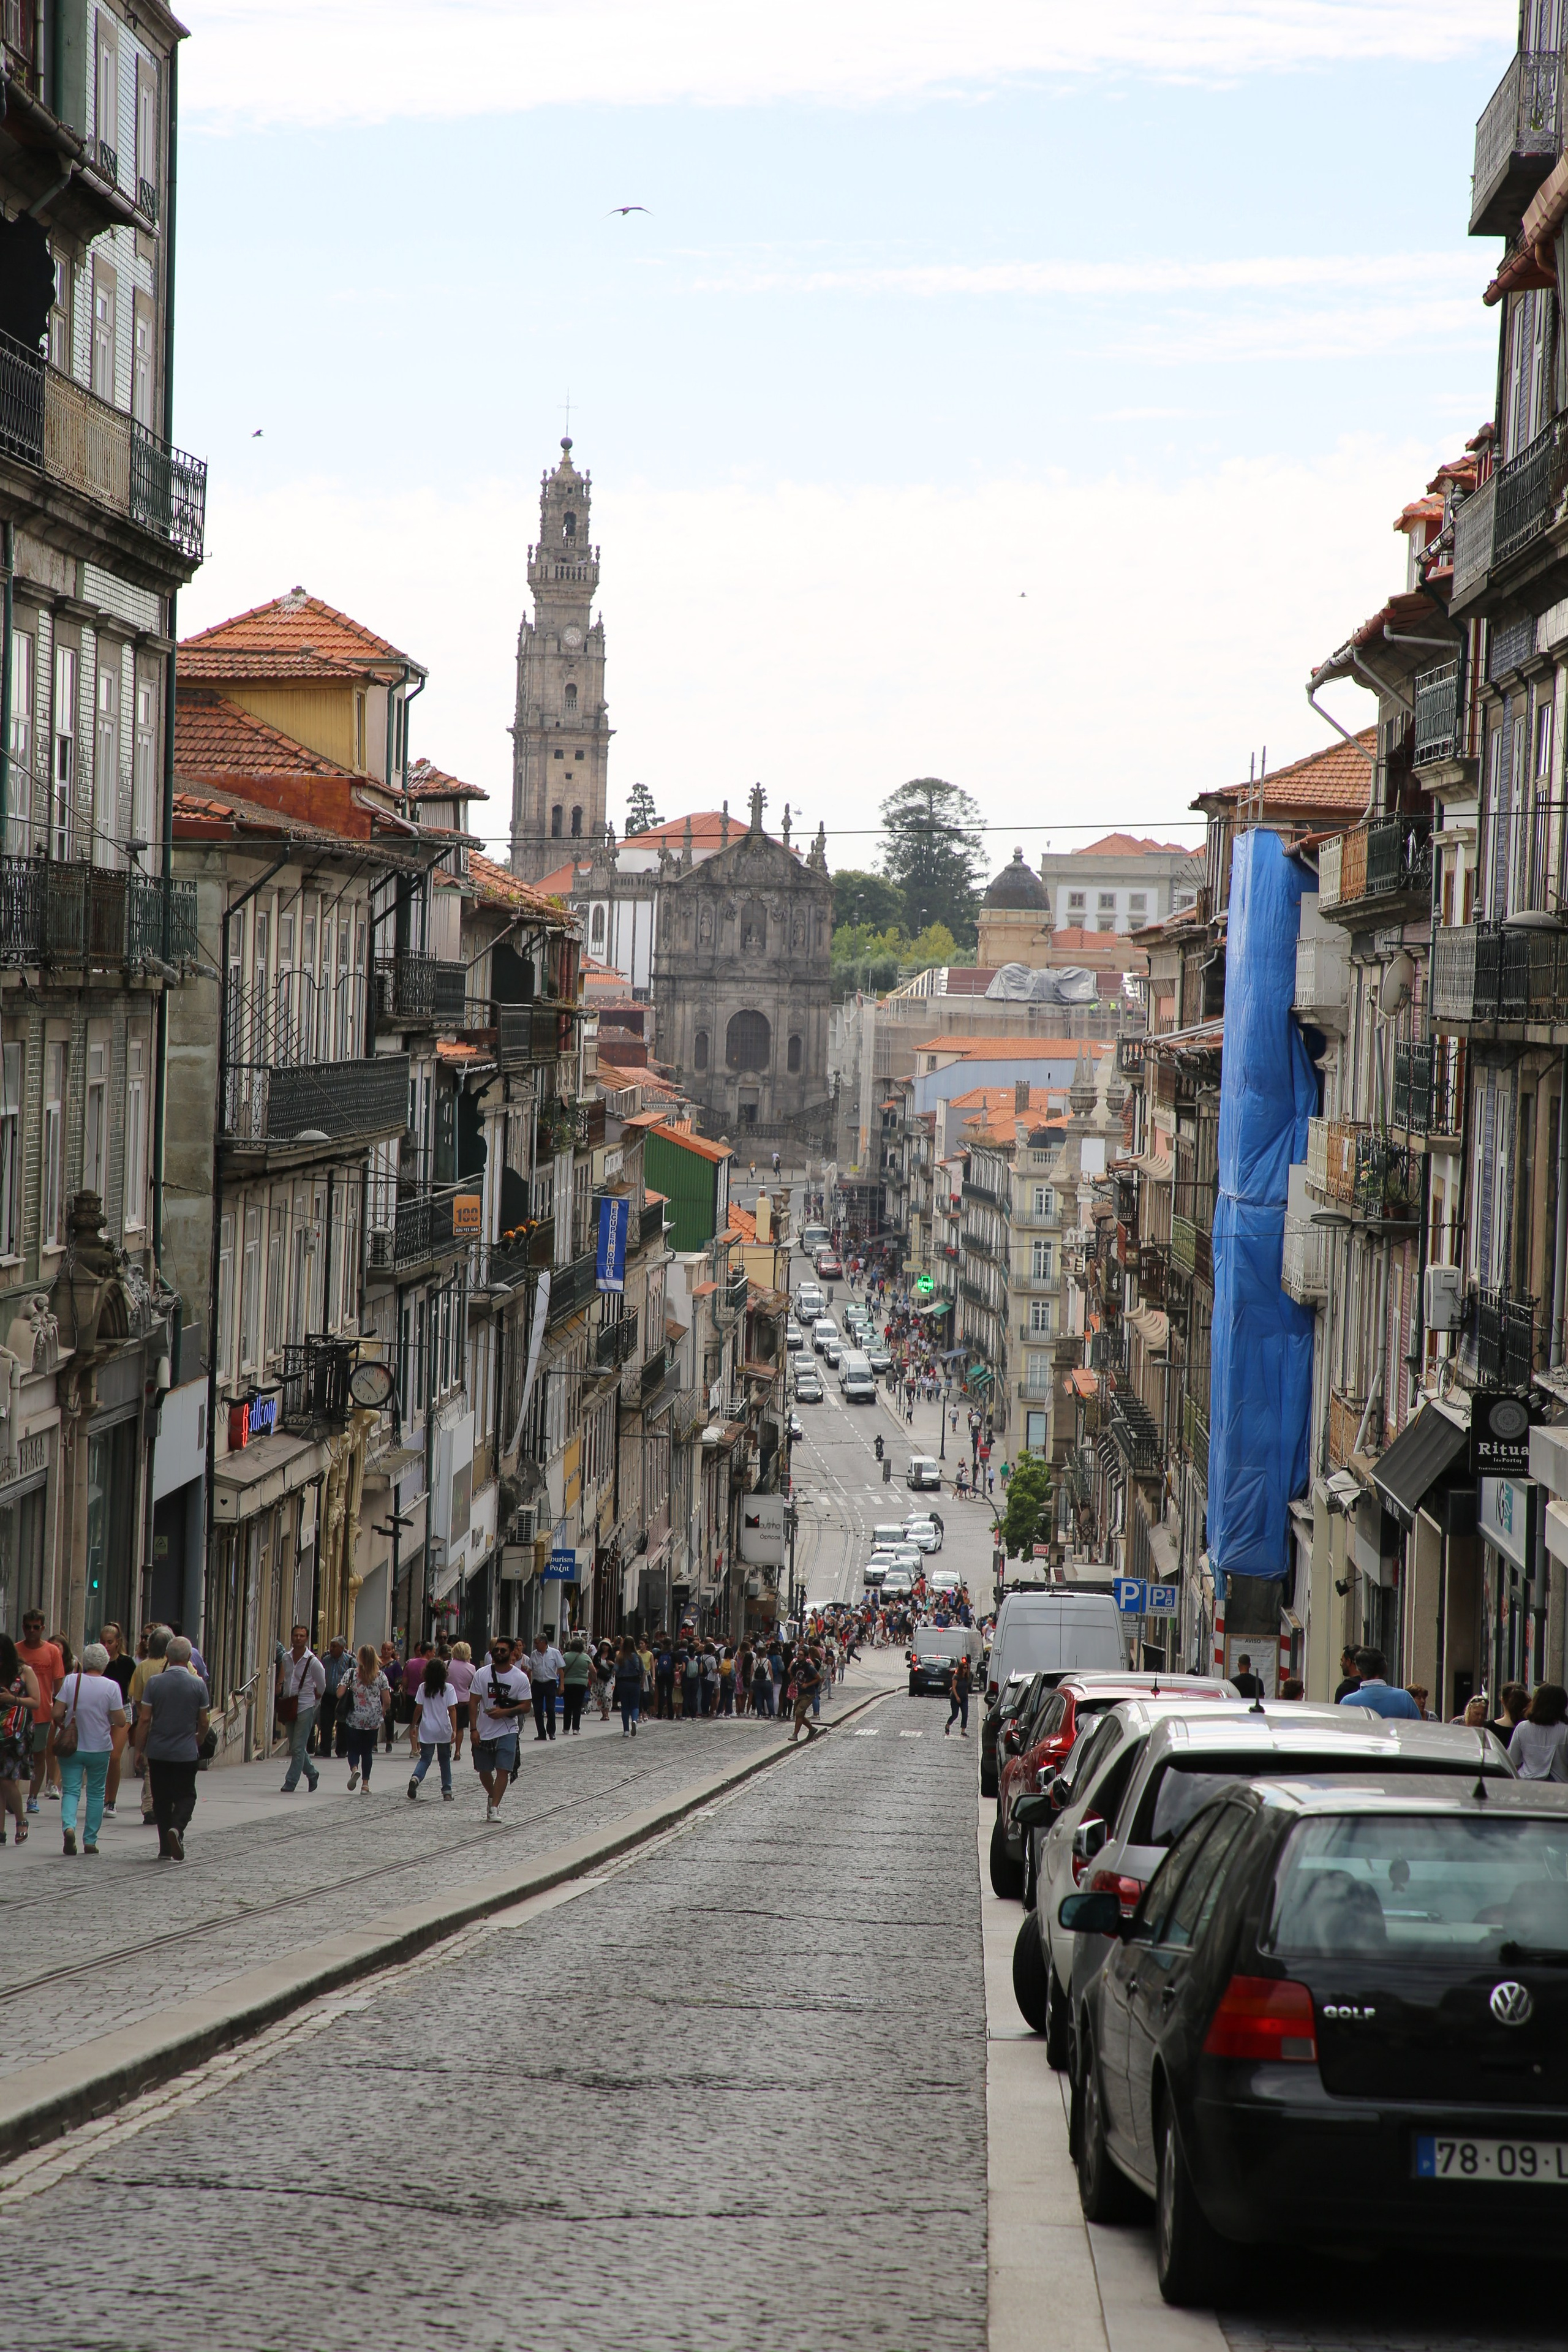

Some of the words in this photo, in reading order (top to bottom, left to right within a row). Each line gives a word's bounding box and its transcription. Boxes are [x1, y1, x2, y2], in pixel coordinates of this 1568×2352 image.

[606, 1200, 619, 1277] RECUPERNORTE
[20, 1437, 45, 1475] BRAGA
[1478, 1442, 1530, 1456] Ritua
[549, 1564, 570, 1573] Point
[1120, 1581, 1140, 1609] P
[1152, 1588, 1166, 1605] P
[1323, 2005, 1376, 2019] GOLF
